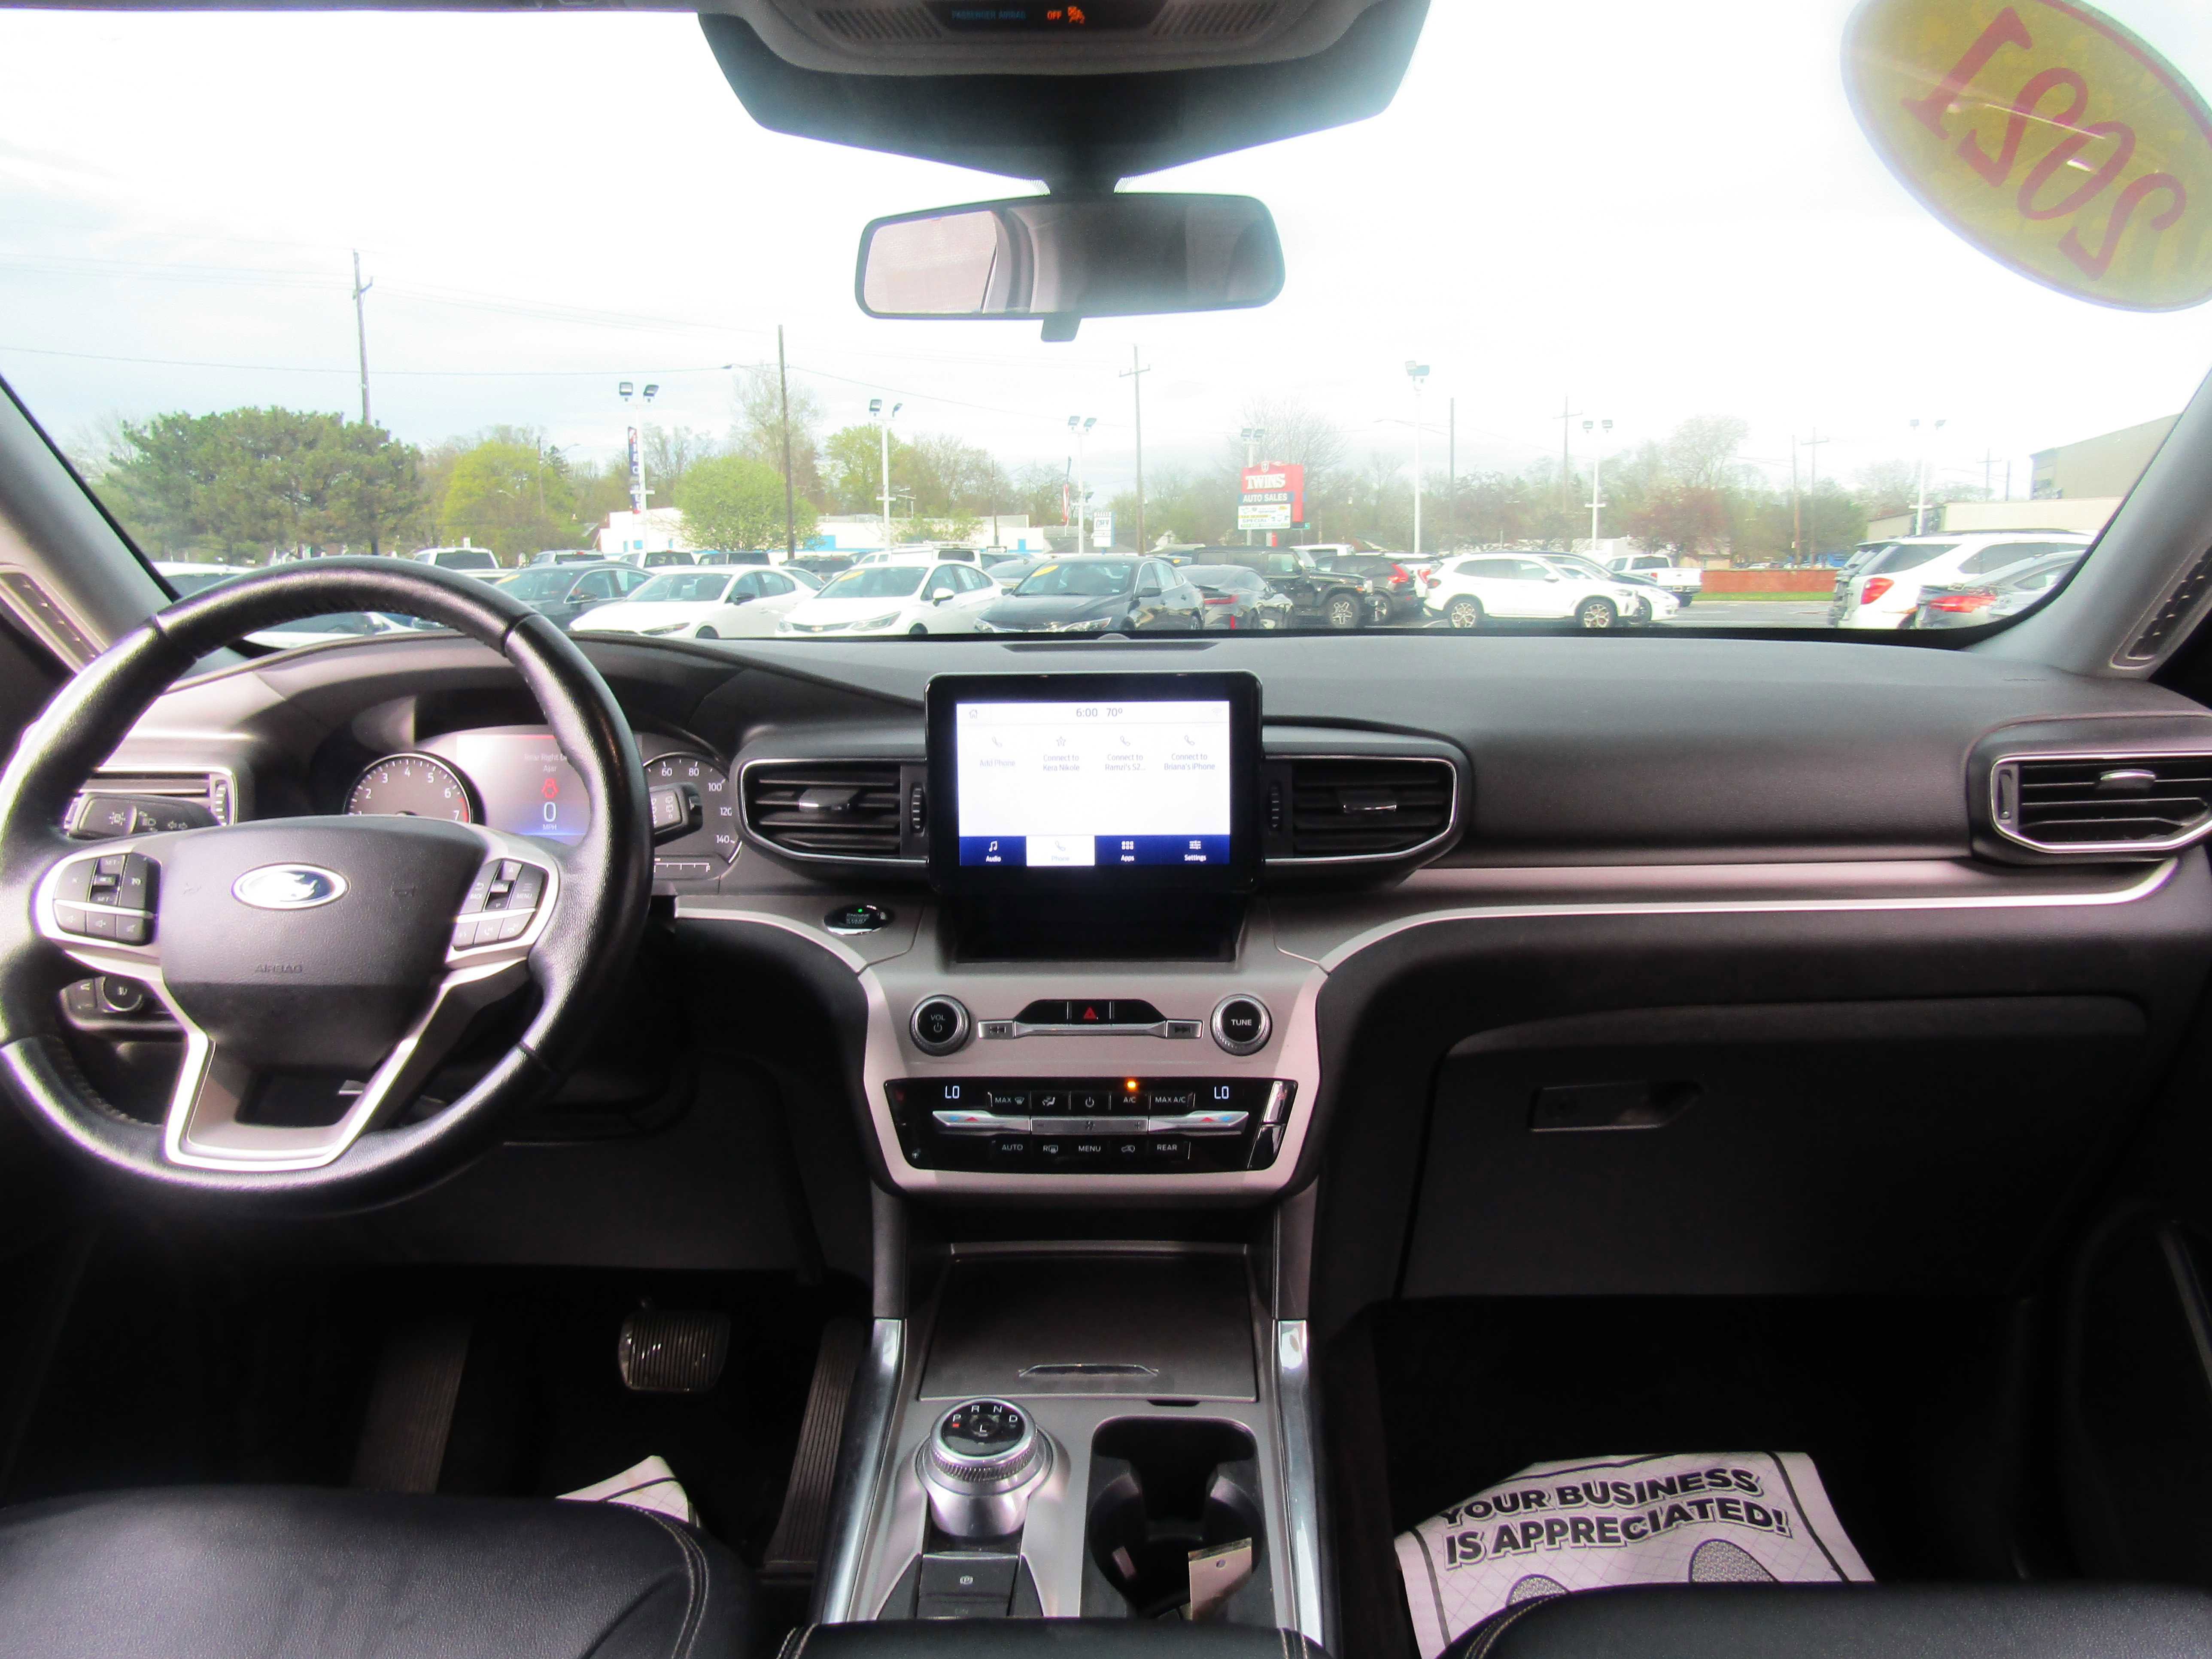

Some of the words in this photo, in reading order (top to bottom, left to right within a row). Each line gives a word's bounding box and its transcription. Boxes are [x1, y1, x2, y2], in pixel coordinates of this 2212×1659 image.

[1047, 10, 1062, 20] OFF
[1246, 474, 1286, 489] TWINS
[1243, 494, 1262, 502] AUTO
[1264, 493, 1288, 501] SALES
[1076, 708, 1098, 717] 6:00
[689, 767, 699, 776] 80
[1192, 762, 1215, 770] iPhone
[405, 767, 411, 778] 4
[428, 772, 434, 784] 5
[662, 768, 673, 777] 60
[382, 773, 388, 784] 3
[444, 787, 451, 798] 6
[708, 783, 722, 792] 100
[365, 788, 371, 799] 2
[453, 810, 460, 821] 7
[544, 801, 556, 823] 0
[716, 835, 729, 844] 140
[1184, 854, 1206, 862] Settings
[945, 1085, 960, 1099] LO
[1214, 1086, 1230, 1100] LO
[971, 1405, 980, 1413] R
[1441, 1489, 1549, 1527] YOUR
[1555, 1468, 1761, 1507] BUSINESS
[1446, 1531, 1485, 1567] IS
[1491, 1497, 1790, 1556] APPRECIATED!
